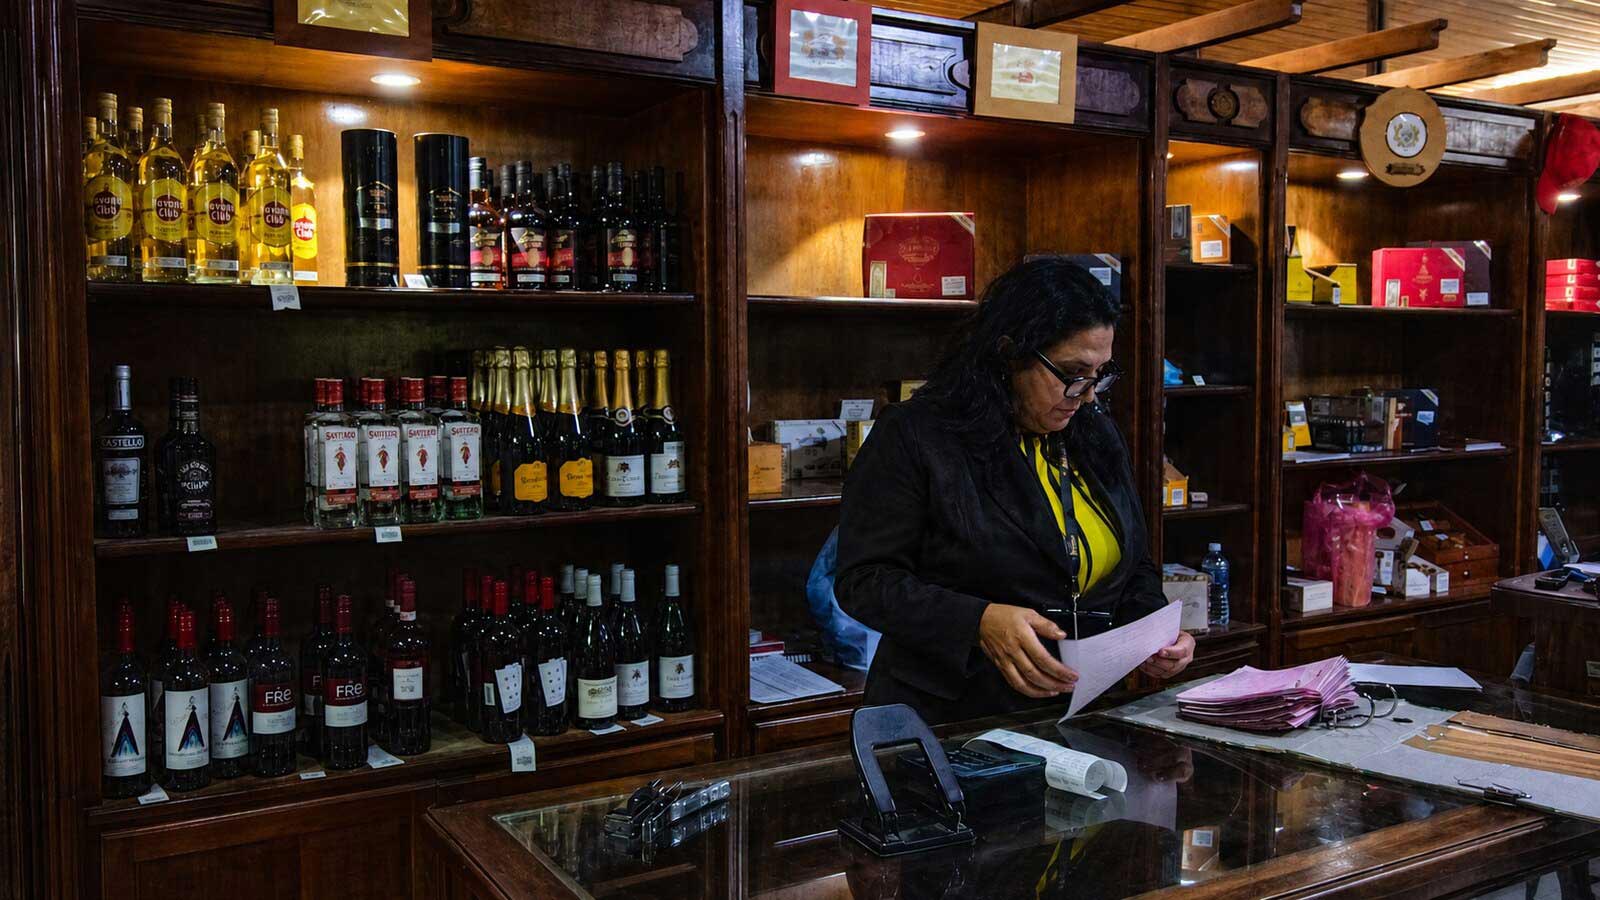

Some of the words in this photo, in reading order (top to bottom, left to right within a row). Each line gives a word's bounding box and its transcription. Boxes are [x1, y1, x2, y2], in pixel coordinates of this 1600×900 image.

[159, 207, 179, 218] Club
[211, 211, 232, 221] Club
[265, 214, 285, 225] Club
[101, 438, 143, 447] CASTELLO
